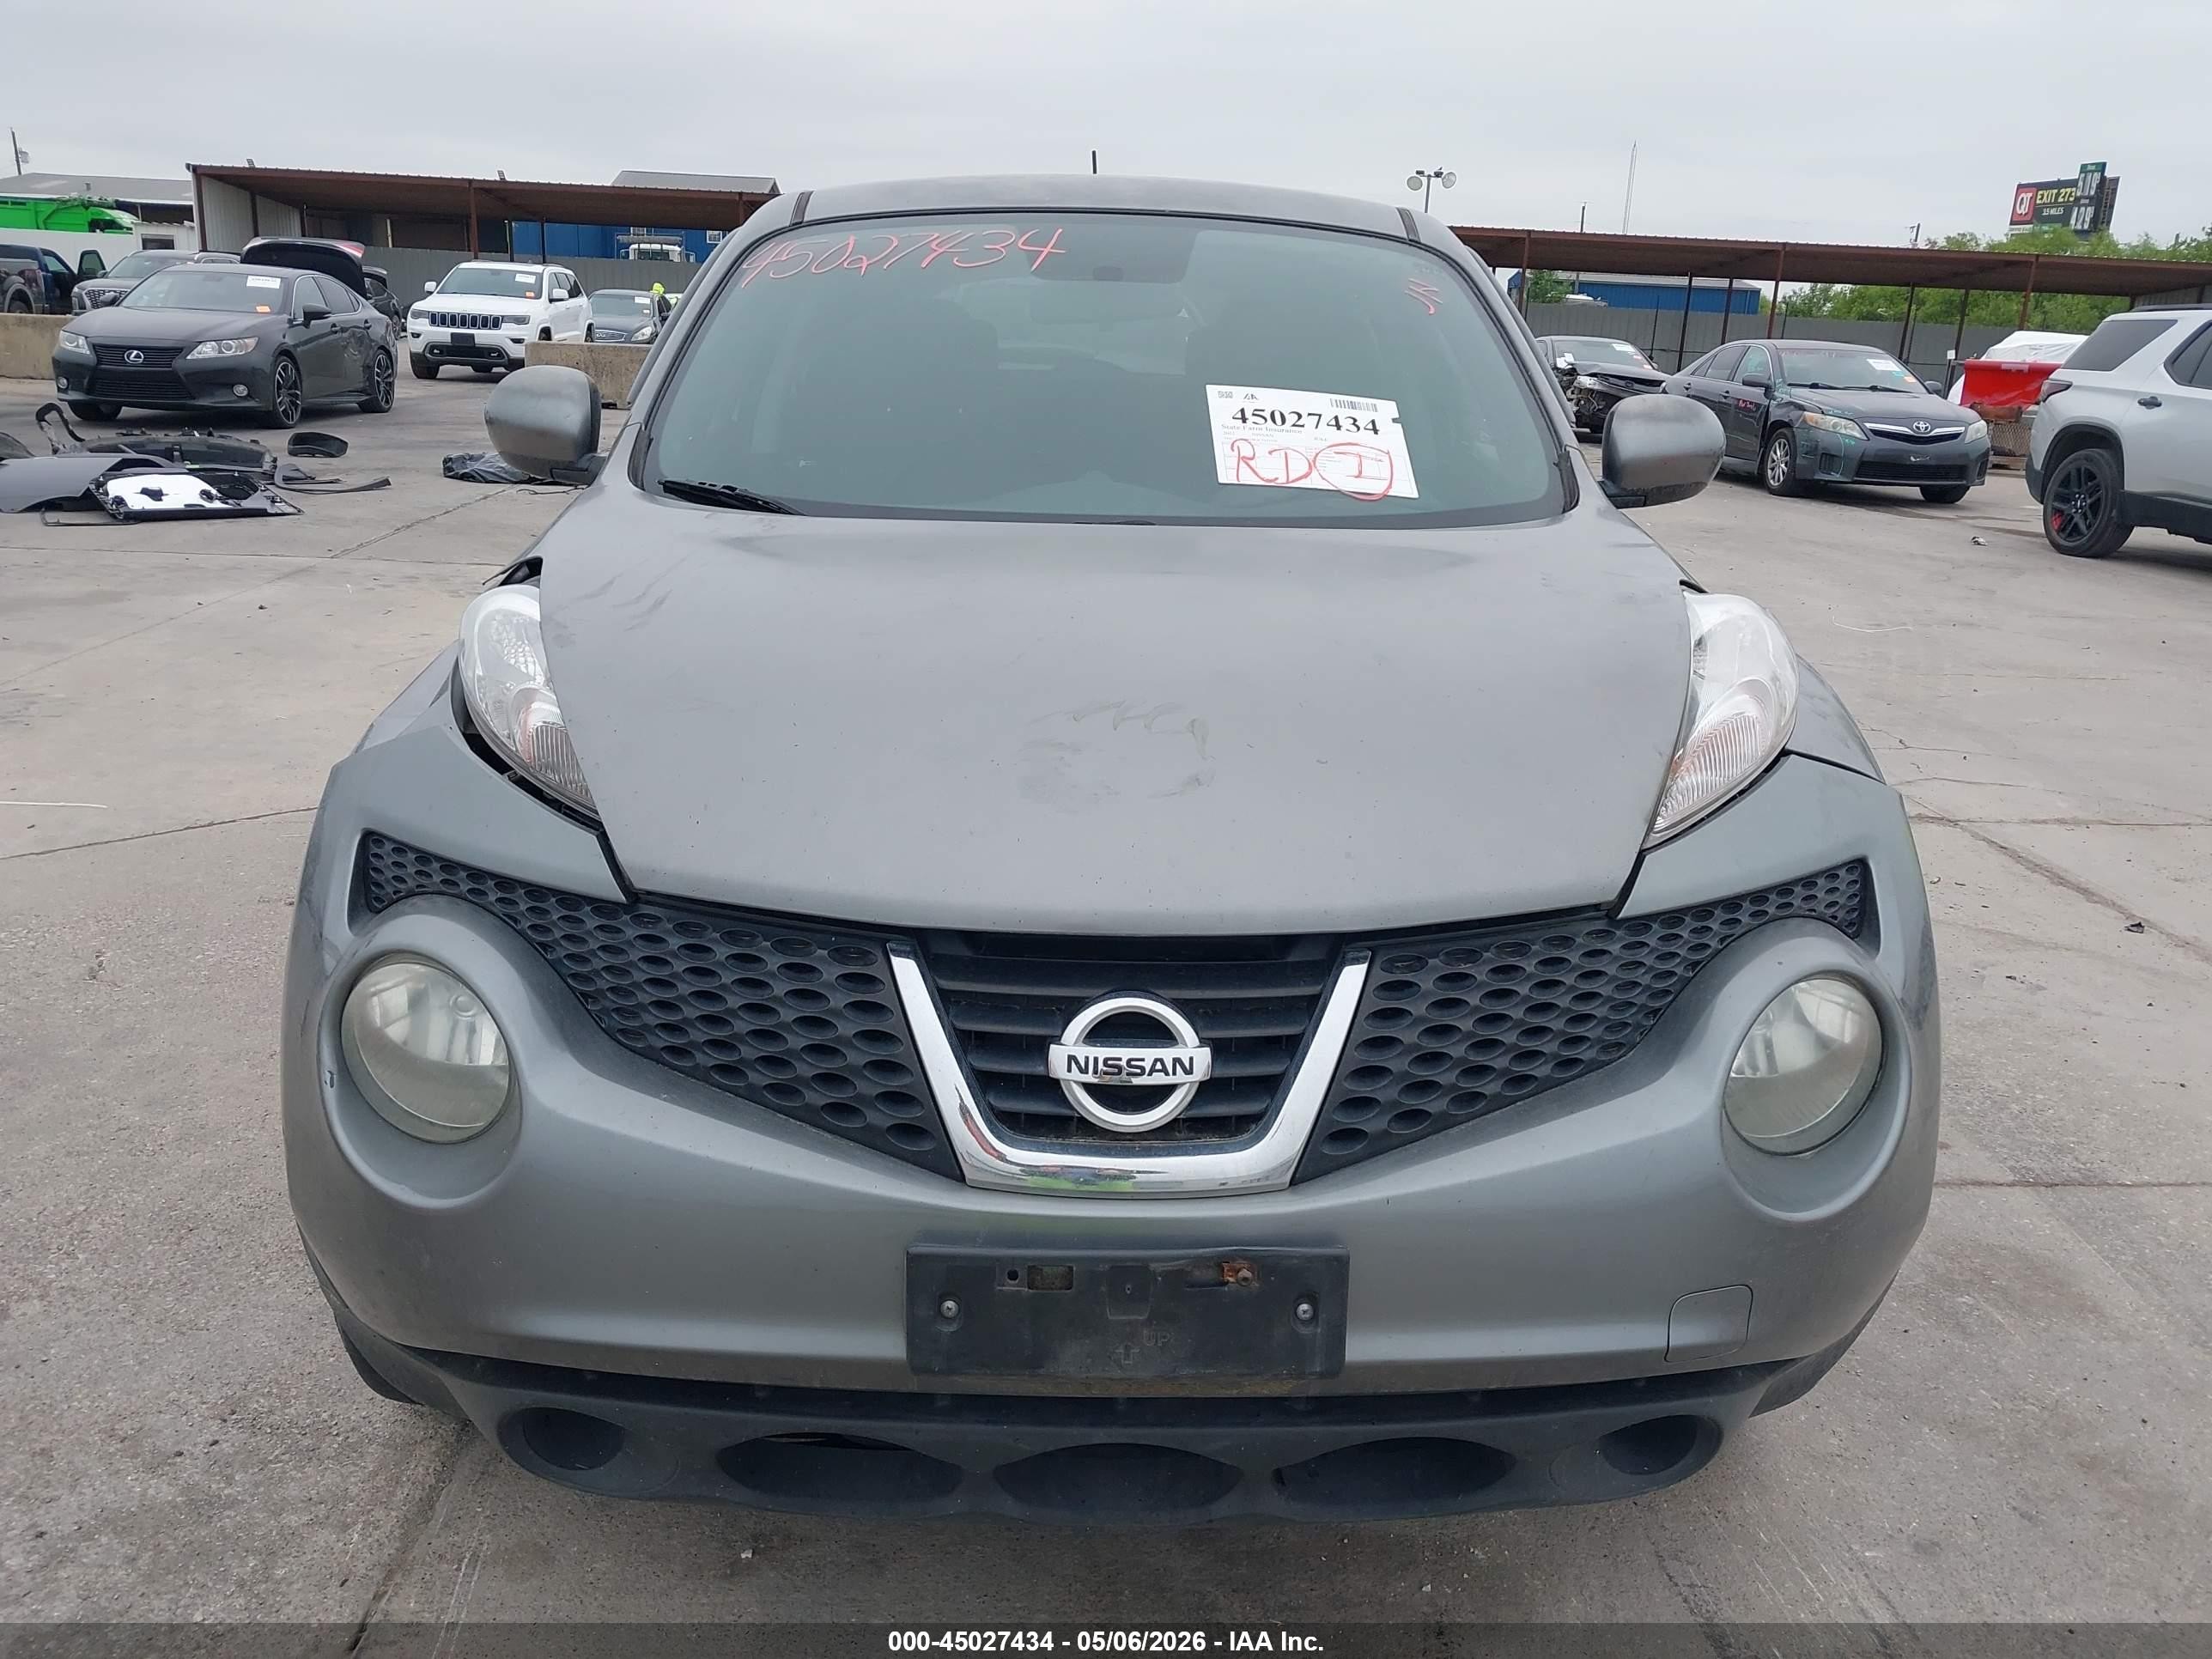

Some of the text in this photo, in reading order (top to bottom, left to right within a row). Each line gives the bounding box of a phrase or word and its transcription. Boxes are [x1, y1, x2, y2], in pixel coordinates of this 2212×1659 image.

[2015, 192, 2033, 216] QT
[2036, 187, 2076, 204] EXIT 273
[2050, 206, 2065, 215] MILES
[742, 228, 1066, 289] 45027434
[1231, 407, 1381, 435] 45027434
[1066, 1054, 1194, 1077] NISSAN
